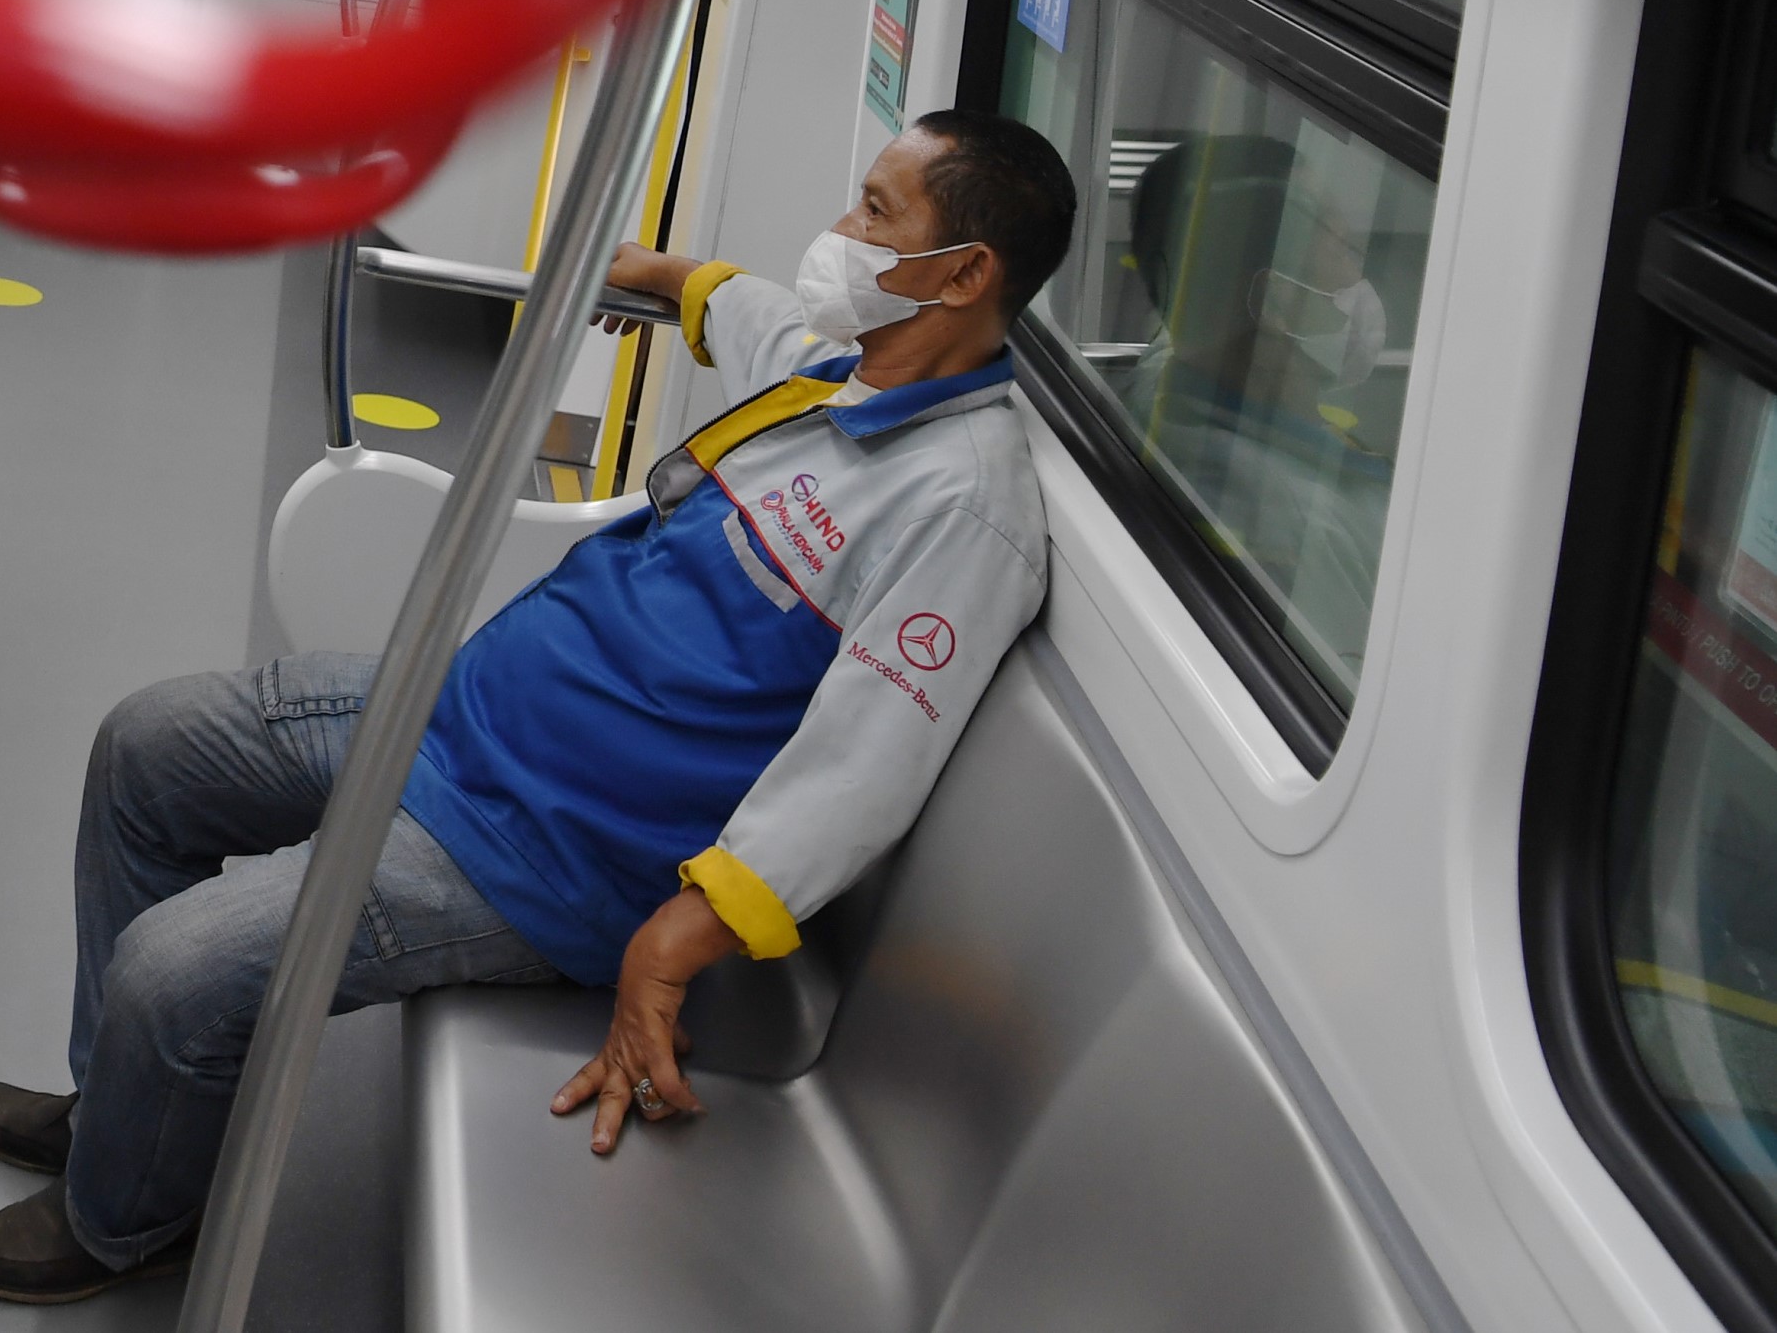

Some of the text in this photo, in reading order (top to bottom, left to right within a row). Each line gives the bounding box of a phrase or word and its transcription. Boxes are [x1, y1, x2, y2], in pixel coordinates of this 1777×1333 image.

[802, 495, 845, 552] HINO
[846, 641, 941, 723] Mercedes-Benz
[1698, 634, 1741, 674] PUSH
[1738, 664, 1762, 691] TO
